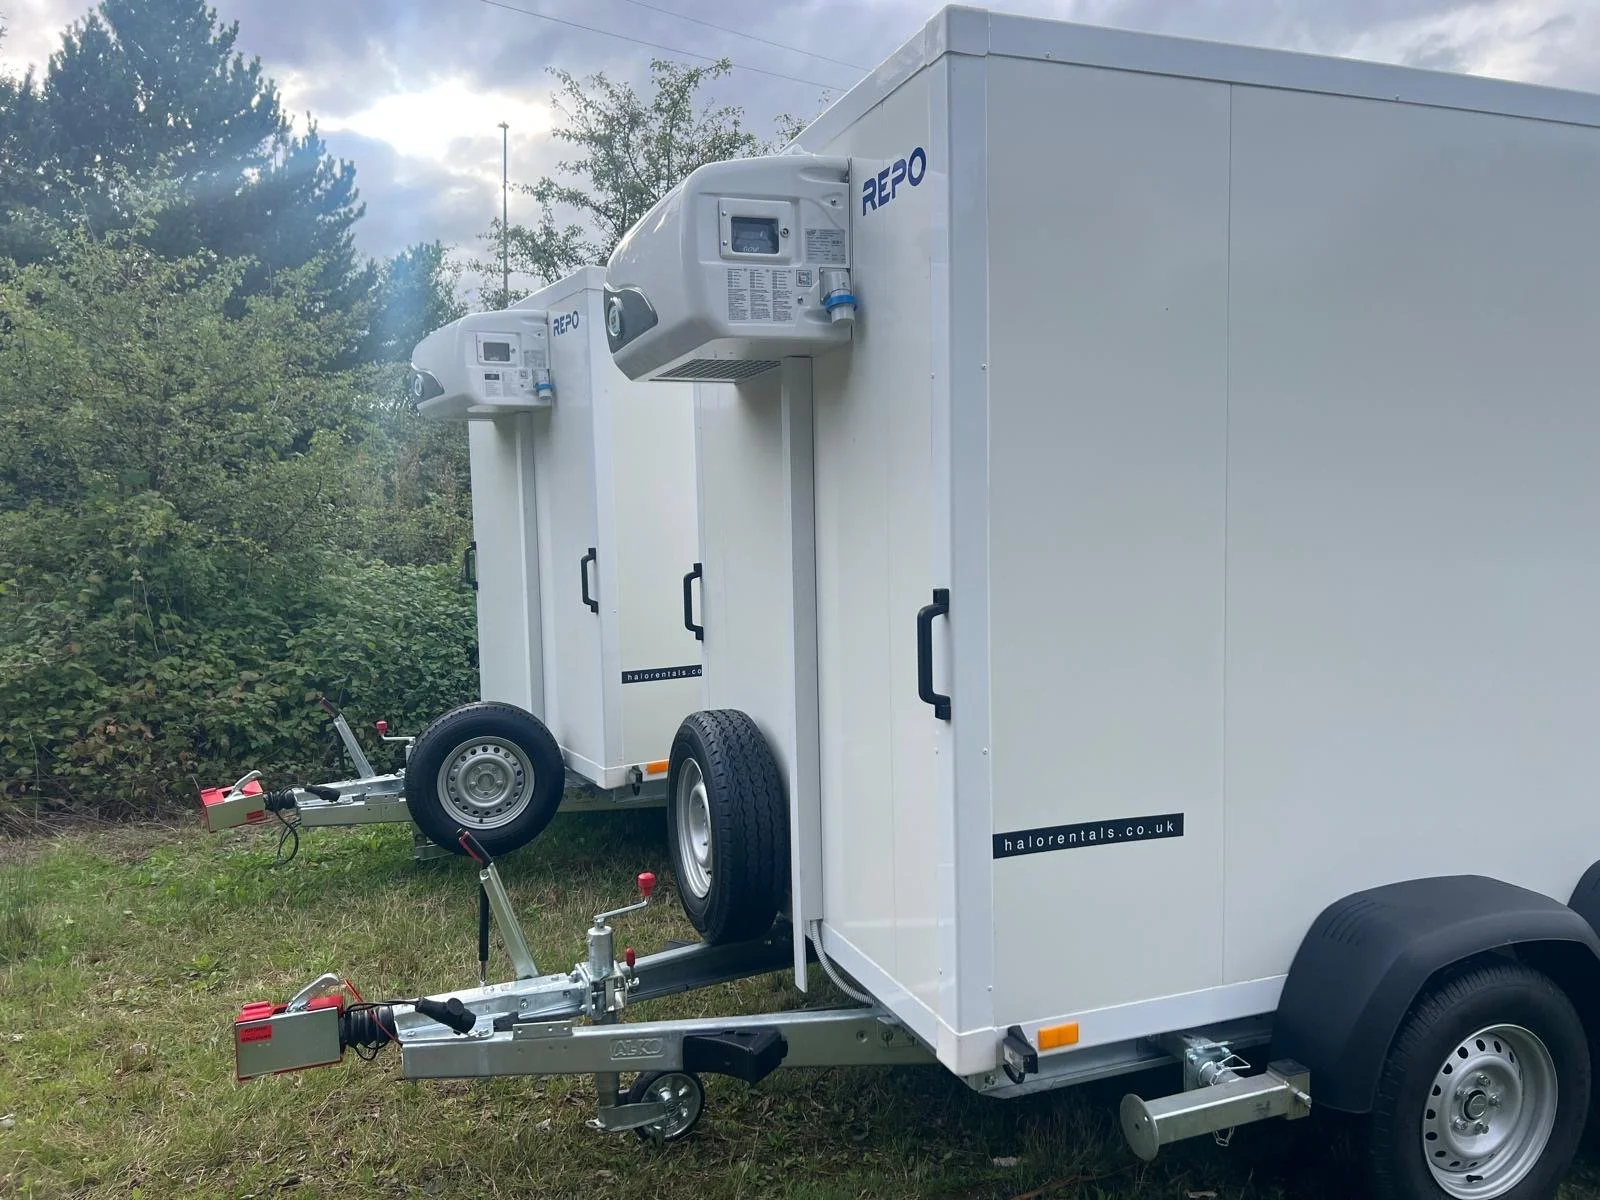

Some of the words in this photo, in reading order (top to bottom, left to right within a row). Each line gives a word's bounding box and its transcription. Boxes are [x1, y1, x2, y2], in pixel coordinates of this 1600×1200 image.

[862, 146, 927, 216] REPO
[553, 310, 580, 337] REPO
[1004, 820, 1175, 851] halorentals.co.uk
